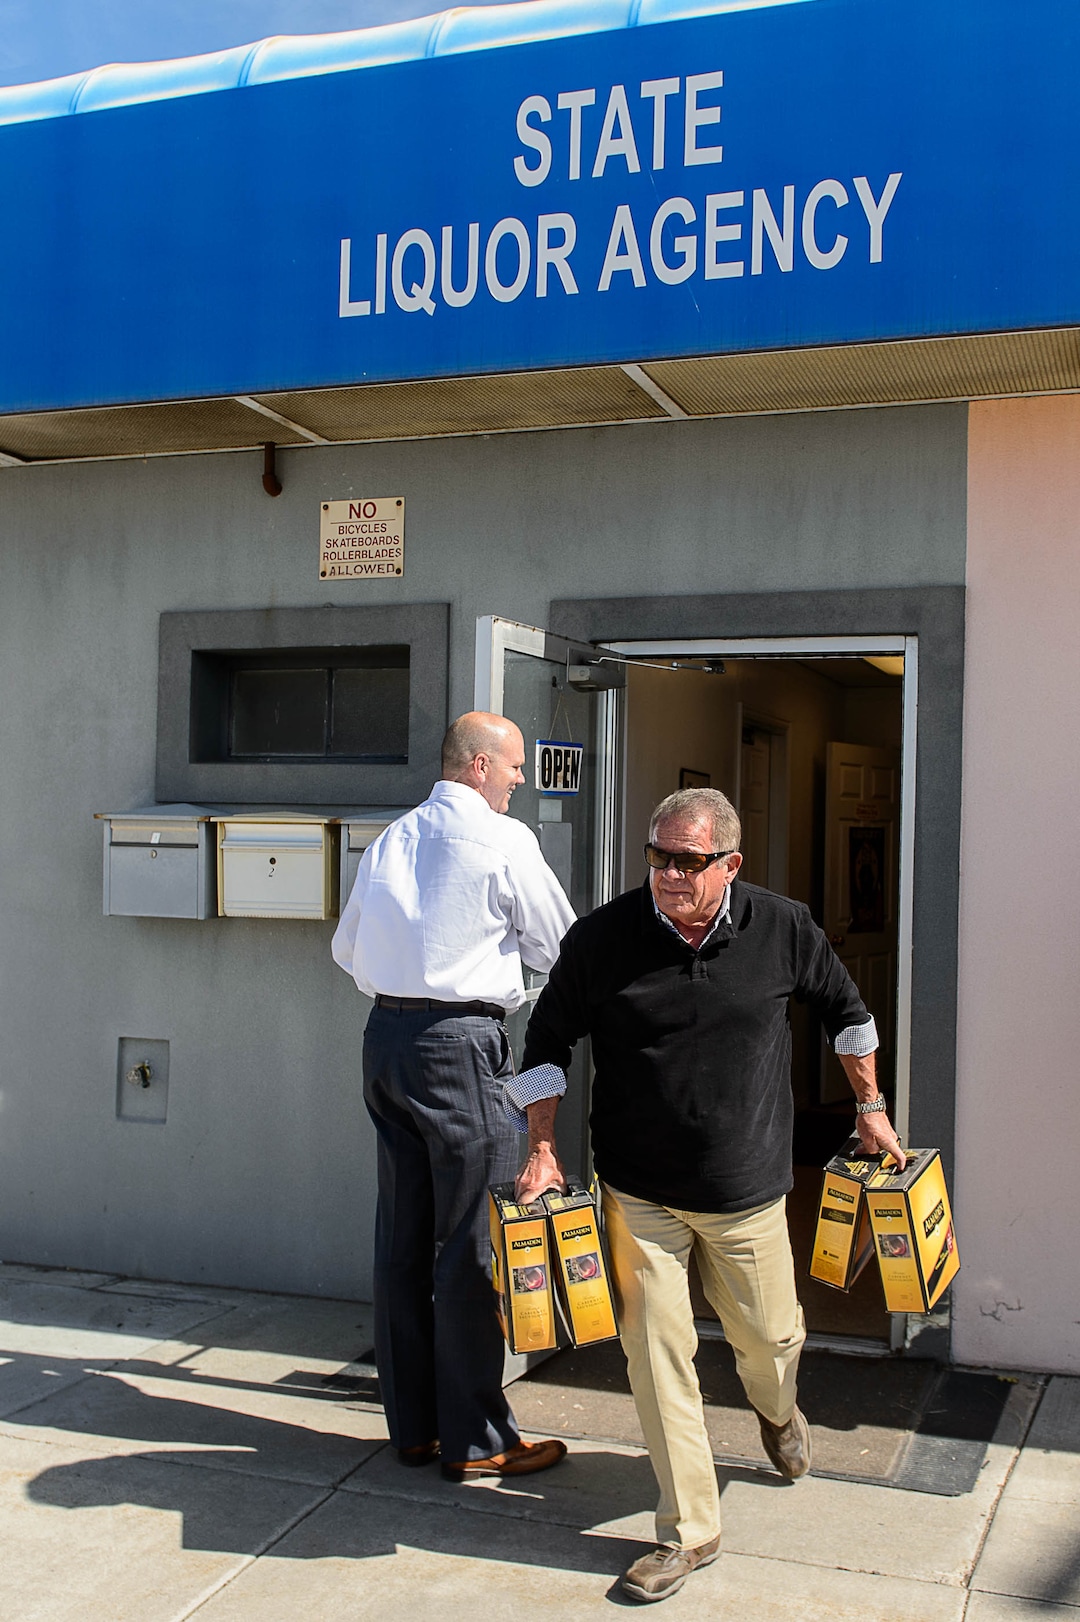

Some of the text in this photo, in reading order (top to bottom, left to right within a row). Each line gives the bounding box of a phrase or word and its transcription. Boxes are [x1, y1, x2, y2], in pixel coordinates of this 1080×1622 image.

[513, 70, 724, 188] STATE
[338, 172, 903, 318] LIQUOR AGENCY
[348, 501, 377, 519] NO
[338, 522, 387, 535] BICYCLES
[325, 535, 400, 549] SKATEBOARDS
[322, 548, 402, 561] ROLLERBLADES
[328, 563, 395, 577] ALLOWED
[541, 747, 581, 789] OPEN
[268, 867, 275, 878] 2
[875, 1209, 903, 1217] ALMADEN
[562, 1226, 591, 1239] ALMADEN
[513, 1238, 542, 1248] ALMADEN
